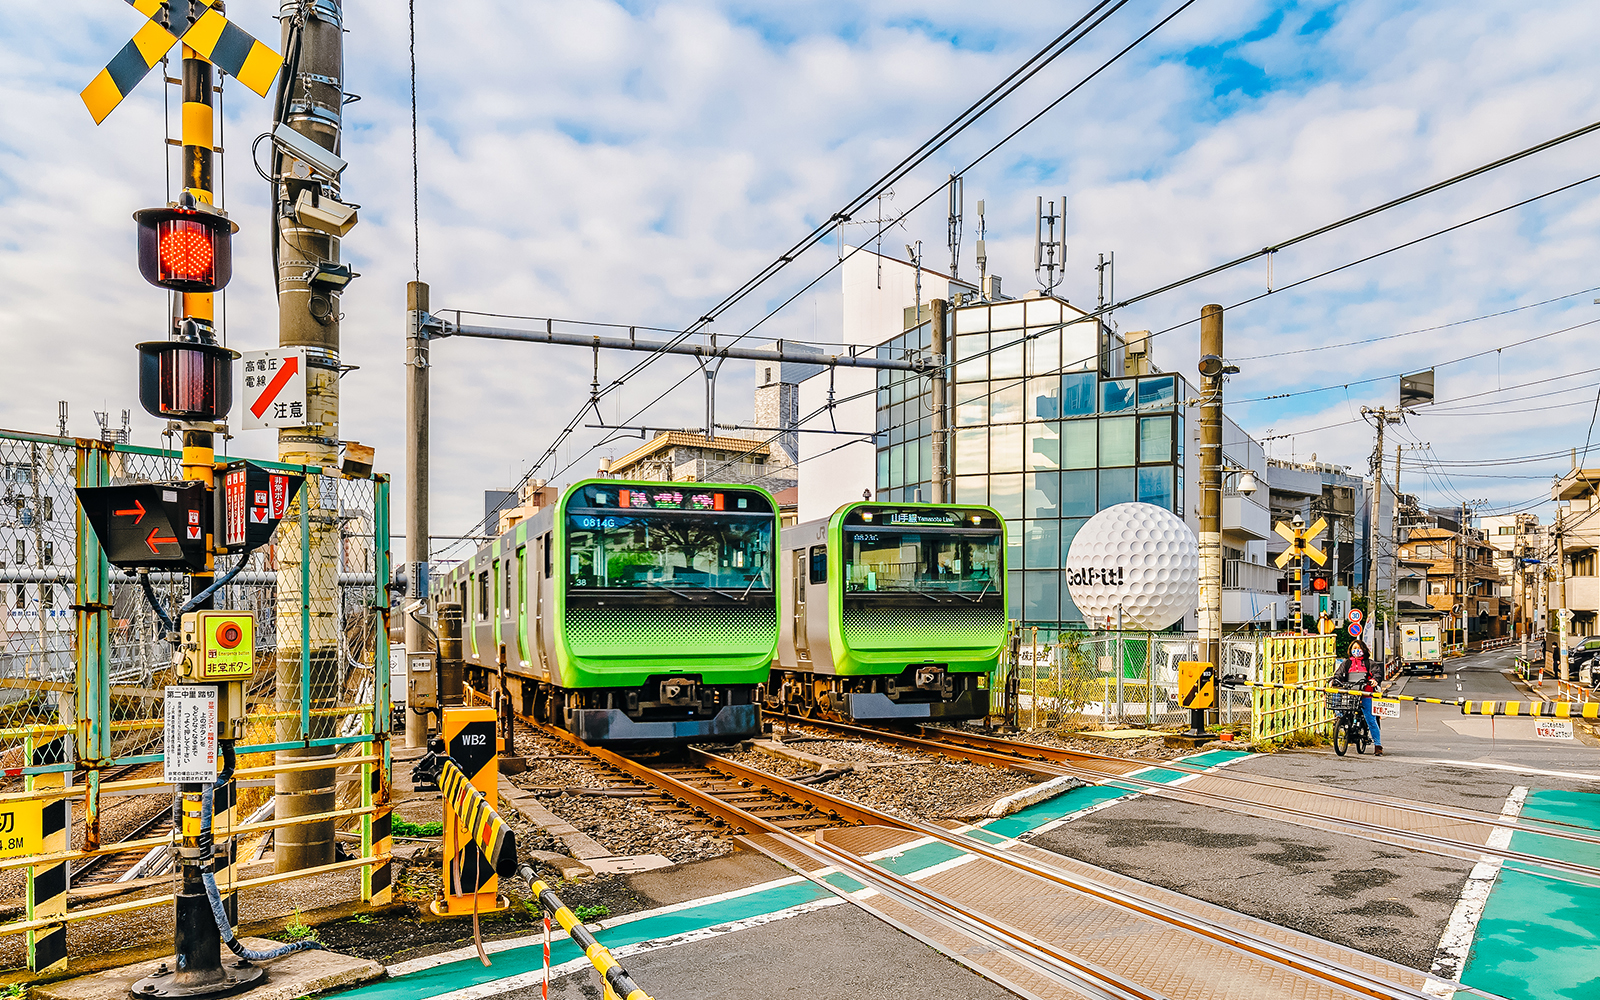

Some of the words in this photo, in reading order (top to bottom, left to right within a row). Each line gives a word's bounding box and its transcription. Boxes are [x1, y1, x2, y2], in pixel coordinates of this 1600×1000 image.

[245, 358, 277, 372] 高電圧
[245, 375, 266, 388] 電線
[273, 401, 303, 418] 注意
[274, 476, 283, 516] 非常ボタン
[583, 518, 615, 527] 0814G
[891, 513, 918, 523] 山手線
[816, 526, 826, 541] JR
[576, 578, 587, 586] 38
[207, 661, 251, 672] 非常ボタン
[461, 734, 487, 746] WB2
